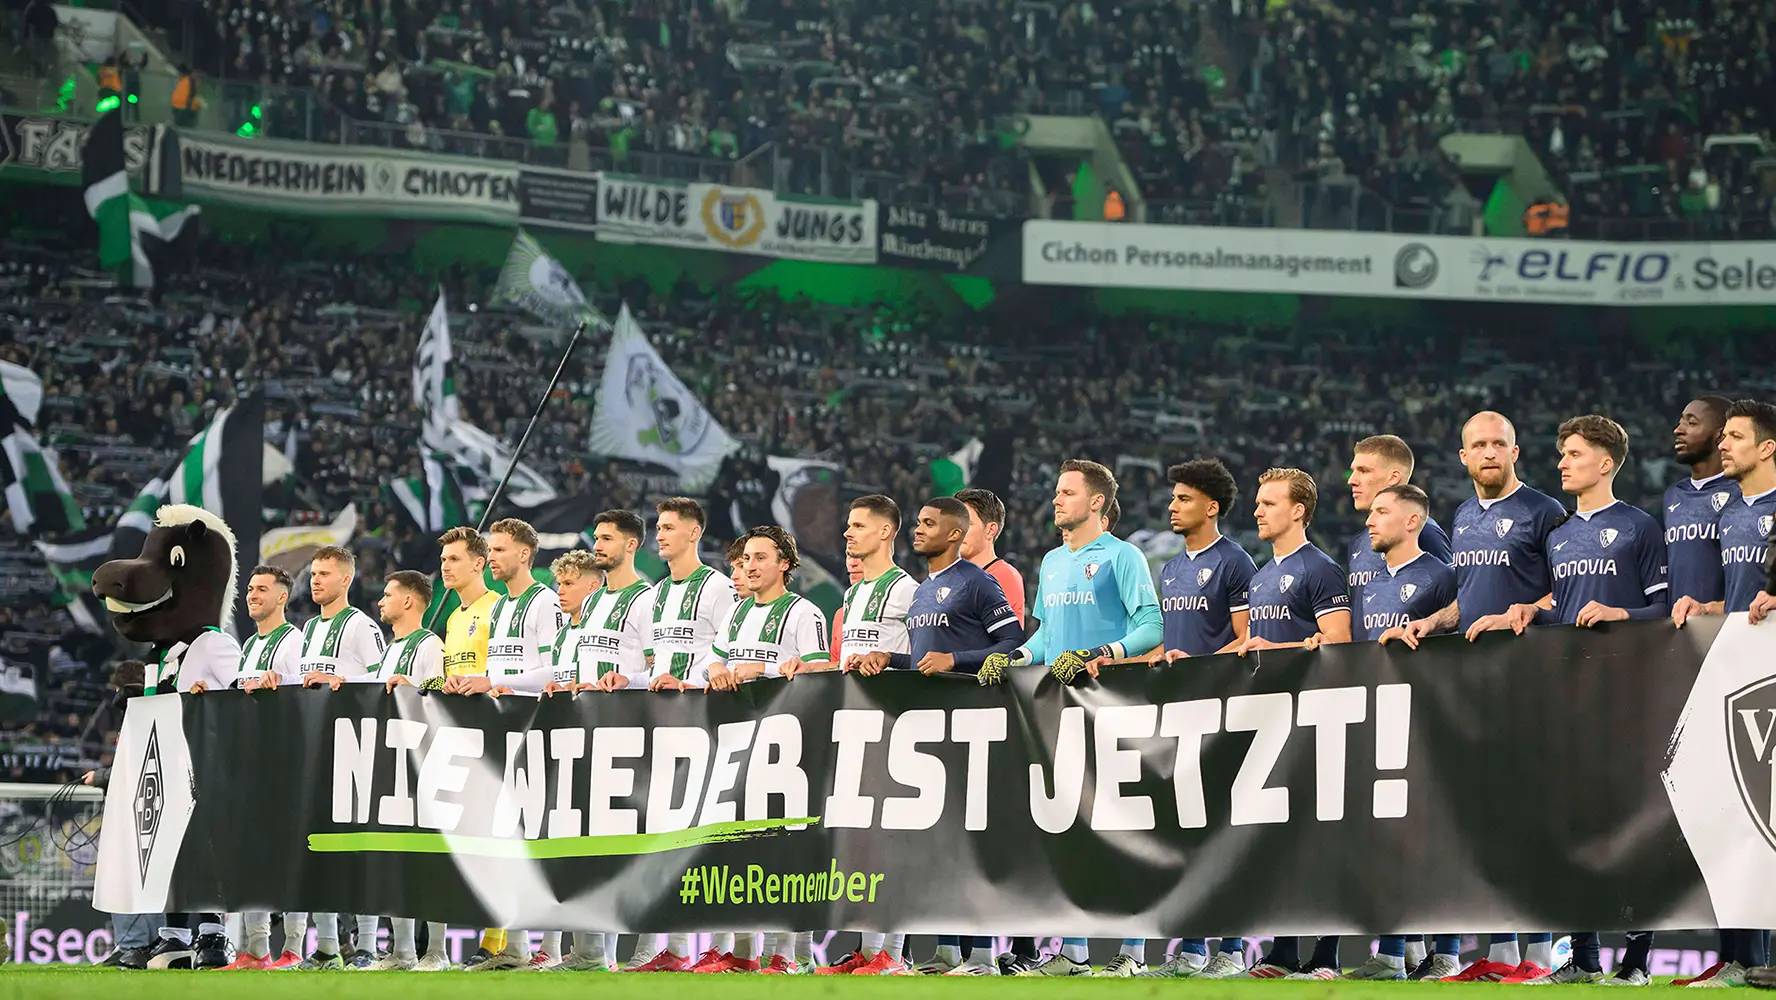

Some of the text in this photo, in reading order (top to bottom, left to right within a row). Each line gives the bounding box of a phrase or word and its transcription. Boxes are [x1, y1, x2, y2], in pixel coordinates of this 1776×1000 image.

[16, 117, 148, 173] FAS
[183, 147, 366, 196] NIEDERRHEIN
[402, 166, 519, 202] CHAOTEN
[604, 184, 688, 227] WILDE
[776, 206, 863, 244] JUNGS
[1040, 241, 1373, 278] Cichon Personalmanagement
[1692, 256, 1776, 291] Sele
[1664, 522, 1720, 545] VONOVI
[1162, 595, 1209, 613] ONOVIA
[1250, 604, 1292, 622] ONOVIA
[906, 611, 950, 631] ONOVIA
[1363, 611, 1411, 630] ONOVIA
[579, 635, 620, 647] EUTER
[653, 626, 694, 638] EUTER
[843, 628, 880, 640] UTER
[445, 651, 476, 664] EUTER
[488, 644, 524, 655] EUTER
[728, 648, 779, 661] EUTER
[300, 662, 336, 673] EUTER
[332, 683, 1412, 841] NIE WIEDER IST JETZT!
[679, 857, 885, 904] #WeRemember
[6, 911, 114, 965] lsec
